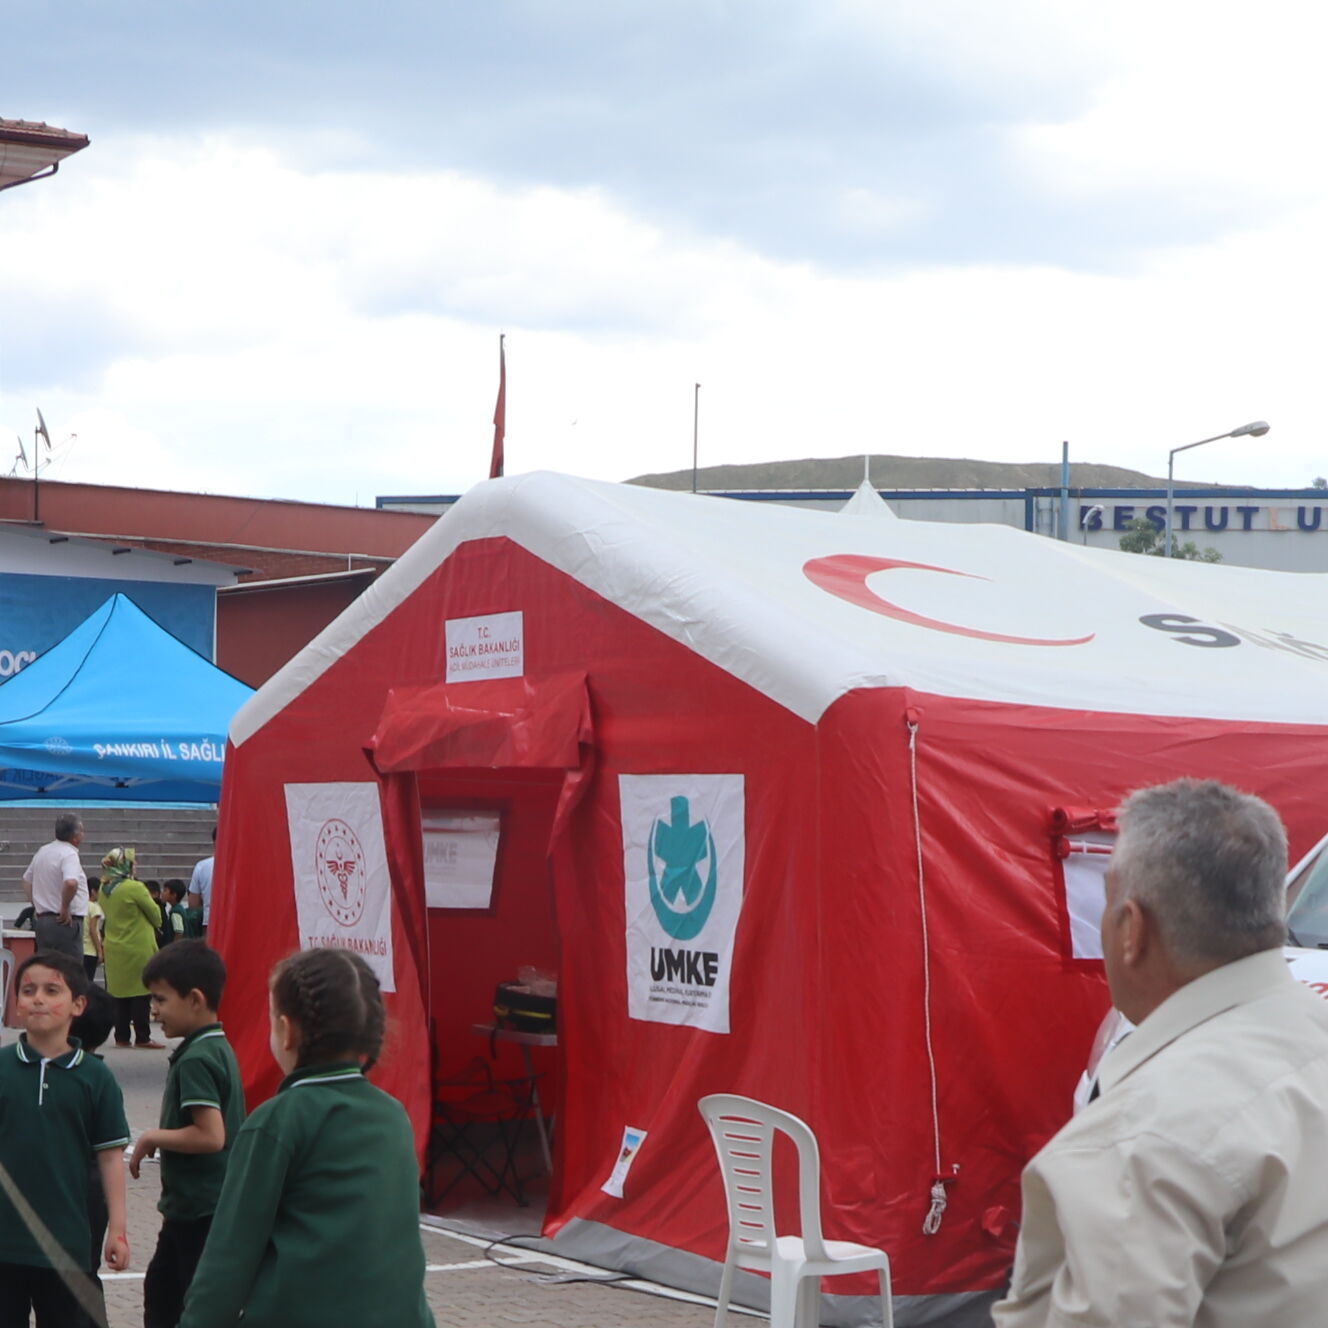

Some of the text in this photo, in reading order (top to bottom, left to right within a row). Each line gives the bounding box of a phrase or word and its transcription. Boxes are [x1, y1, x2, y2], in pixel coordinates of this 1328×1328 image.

[449, 636, 520, 658] SAĞLIK BAKANLIĞI
[93, 738, 225, 763] ÇANKIRI İL SAĞLI
[650, 946, 719, 987] UMKE
